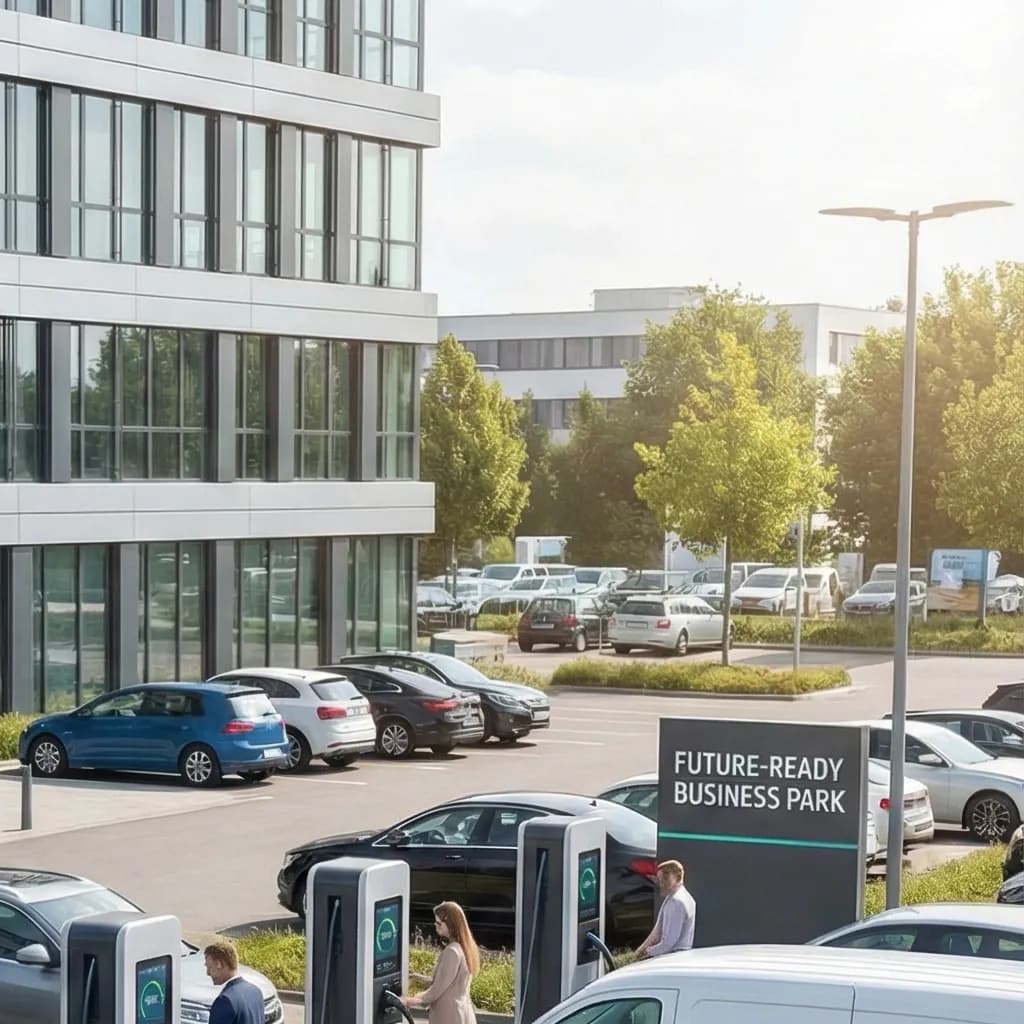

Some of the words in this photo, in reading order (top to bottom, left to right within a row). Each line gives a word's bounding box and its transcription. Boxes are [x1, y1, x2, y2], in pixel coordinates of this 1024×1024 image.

[674, 750, 843, 782] FUTURE-READY
[674, 781, 780, 810] BUSINESS
[787, 787, 846, 814] PARK
